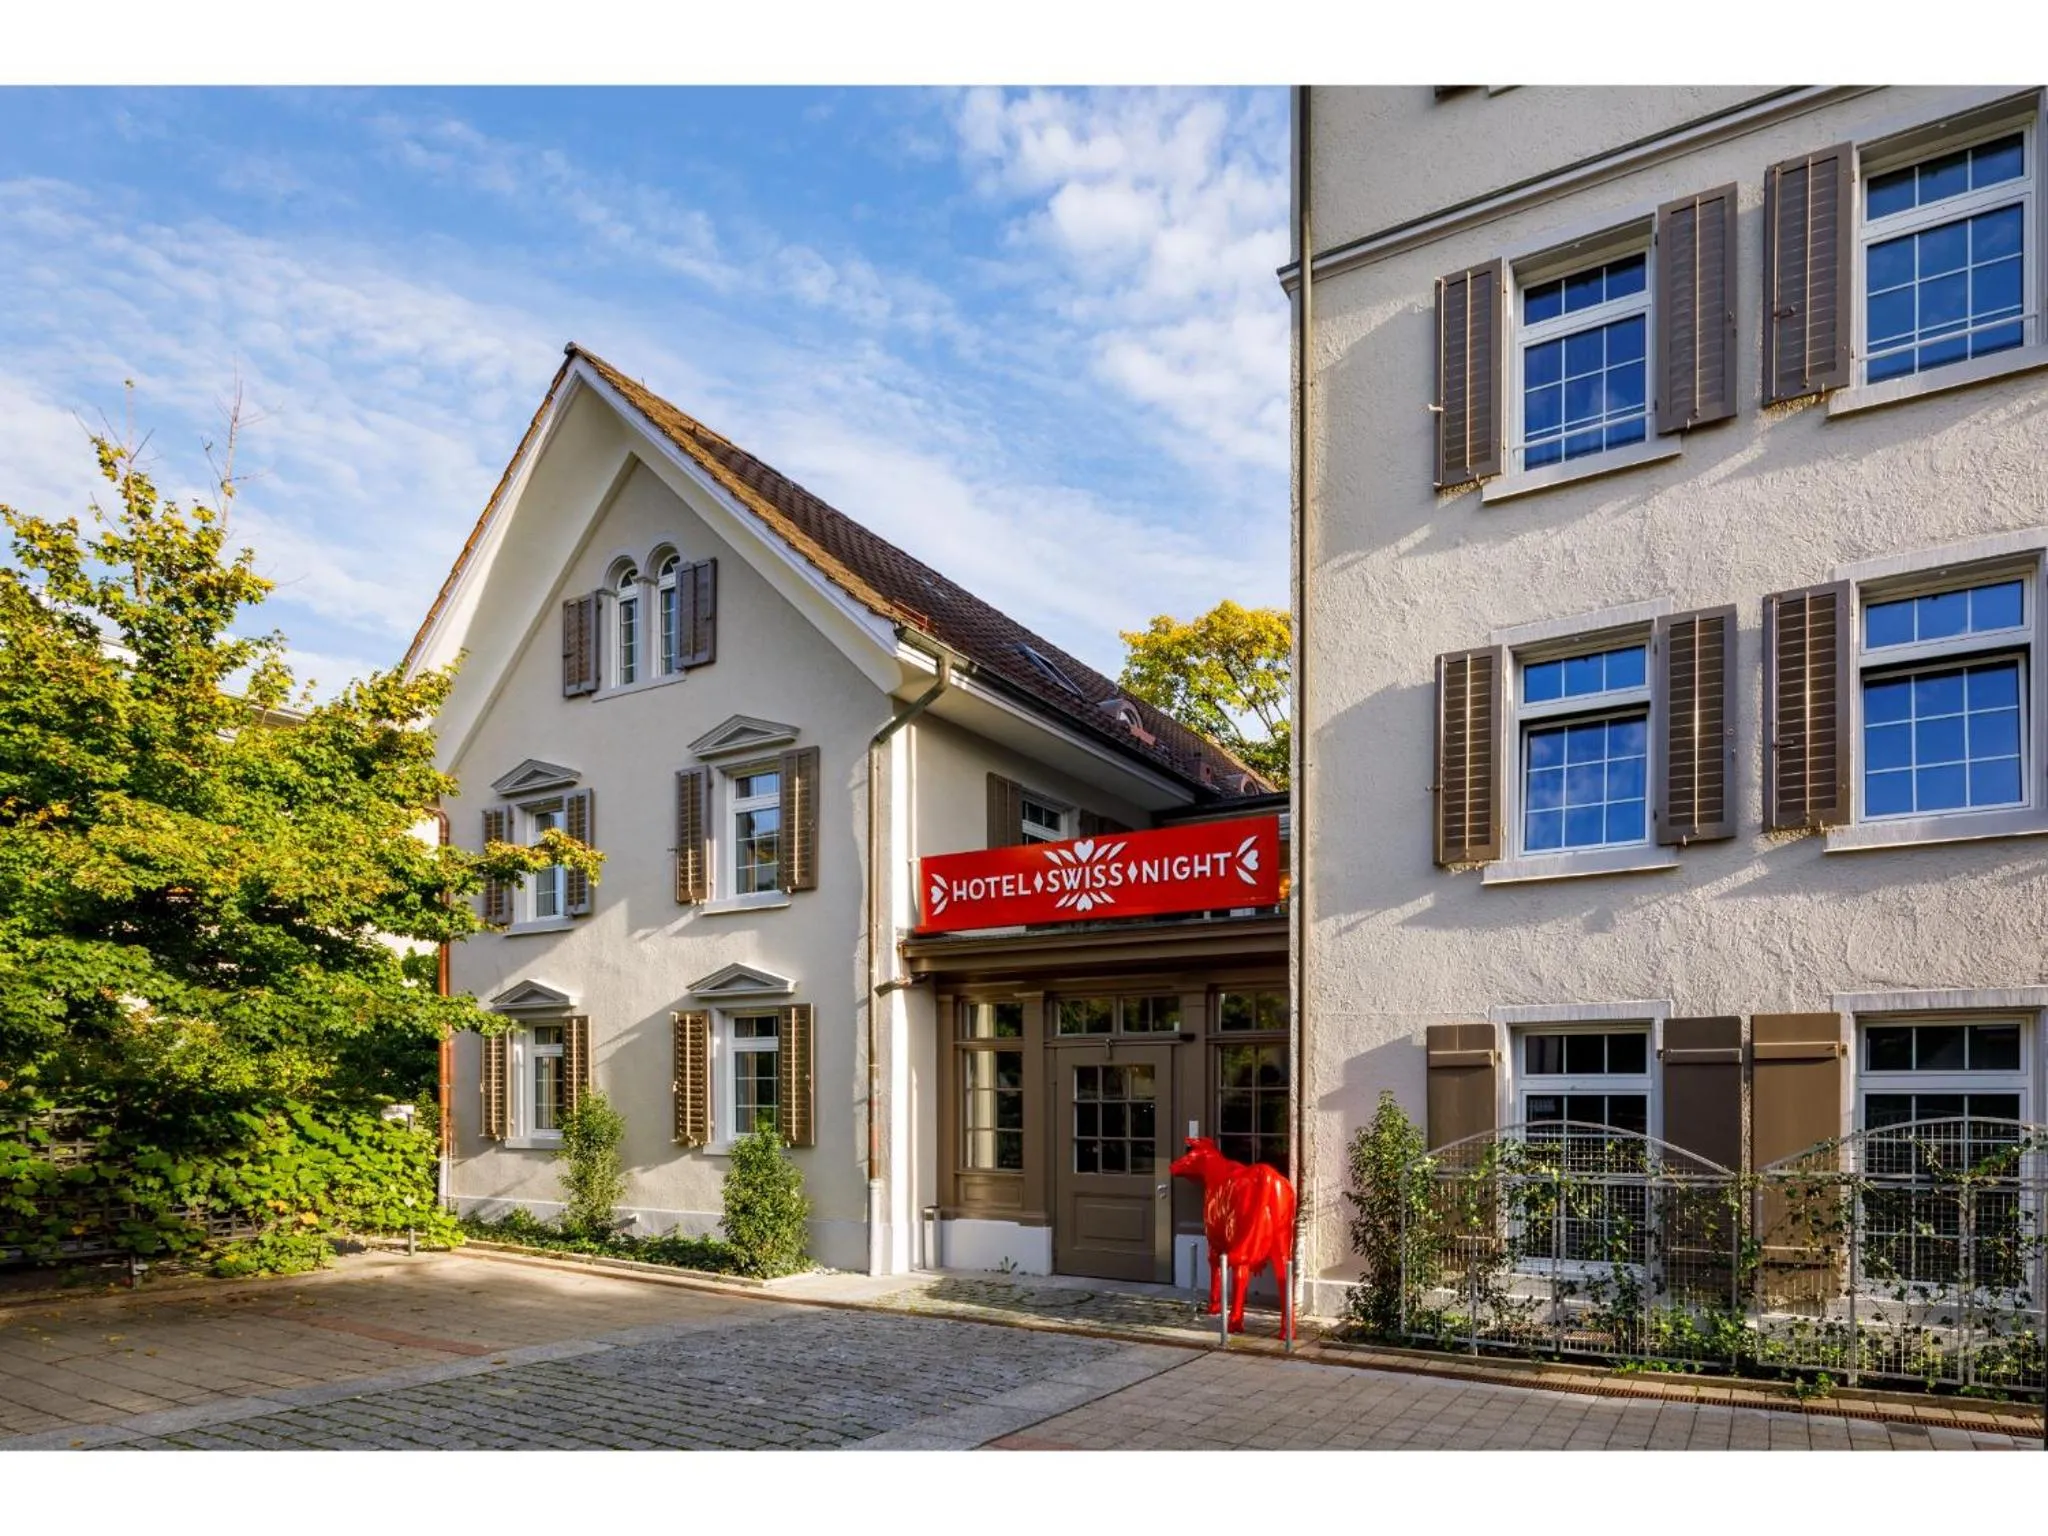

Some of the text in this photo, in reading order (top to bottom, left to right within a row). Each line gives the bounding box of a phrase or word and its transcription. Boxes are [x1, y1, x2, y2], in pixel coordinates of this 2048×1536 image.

[952, 852, 1232, 902] HOTEL SWISS NIGHT
